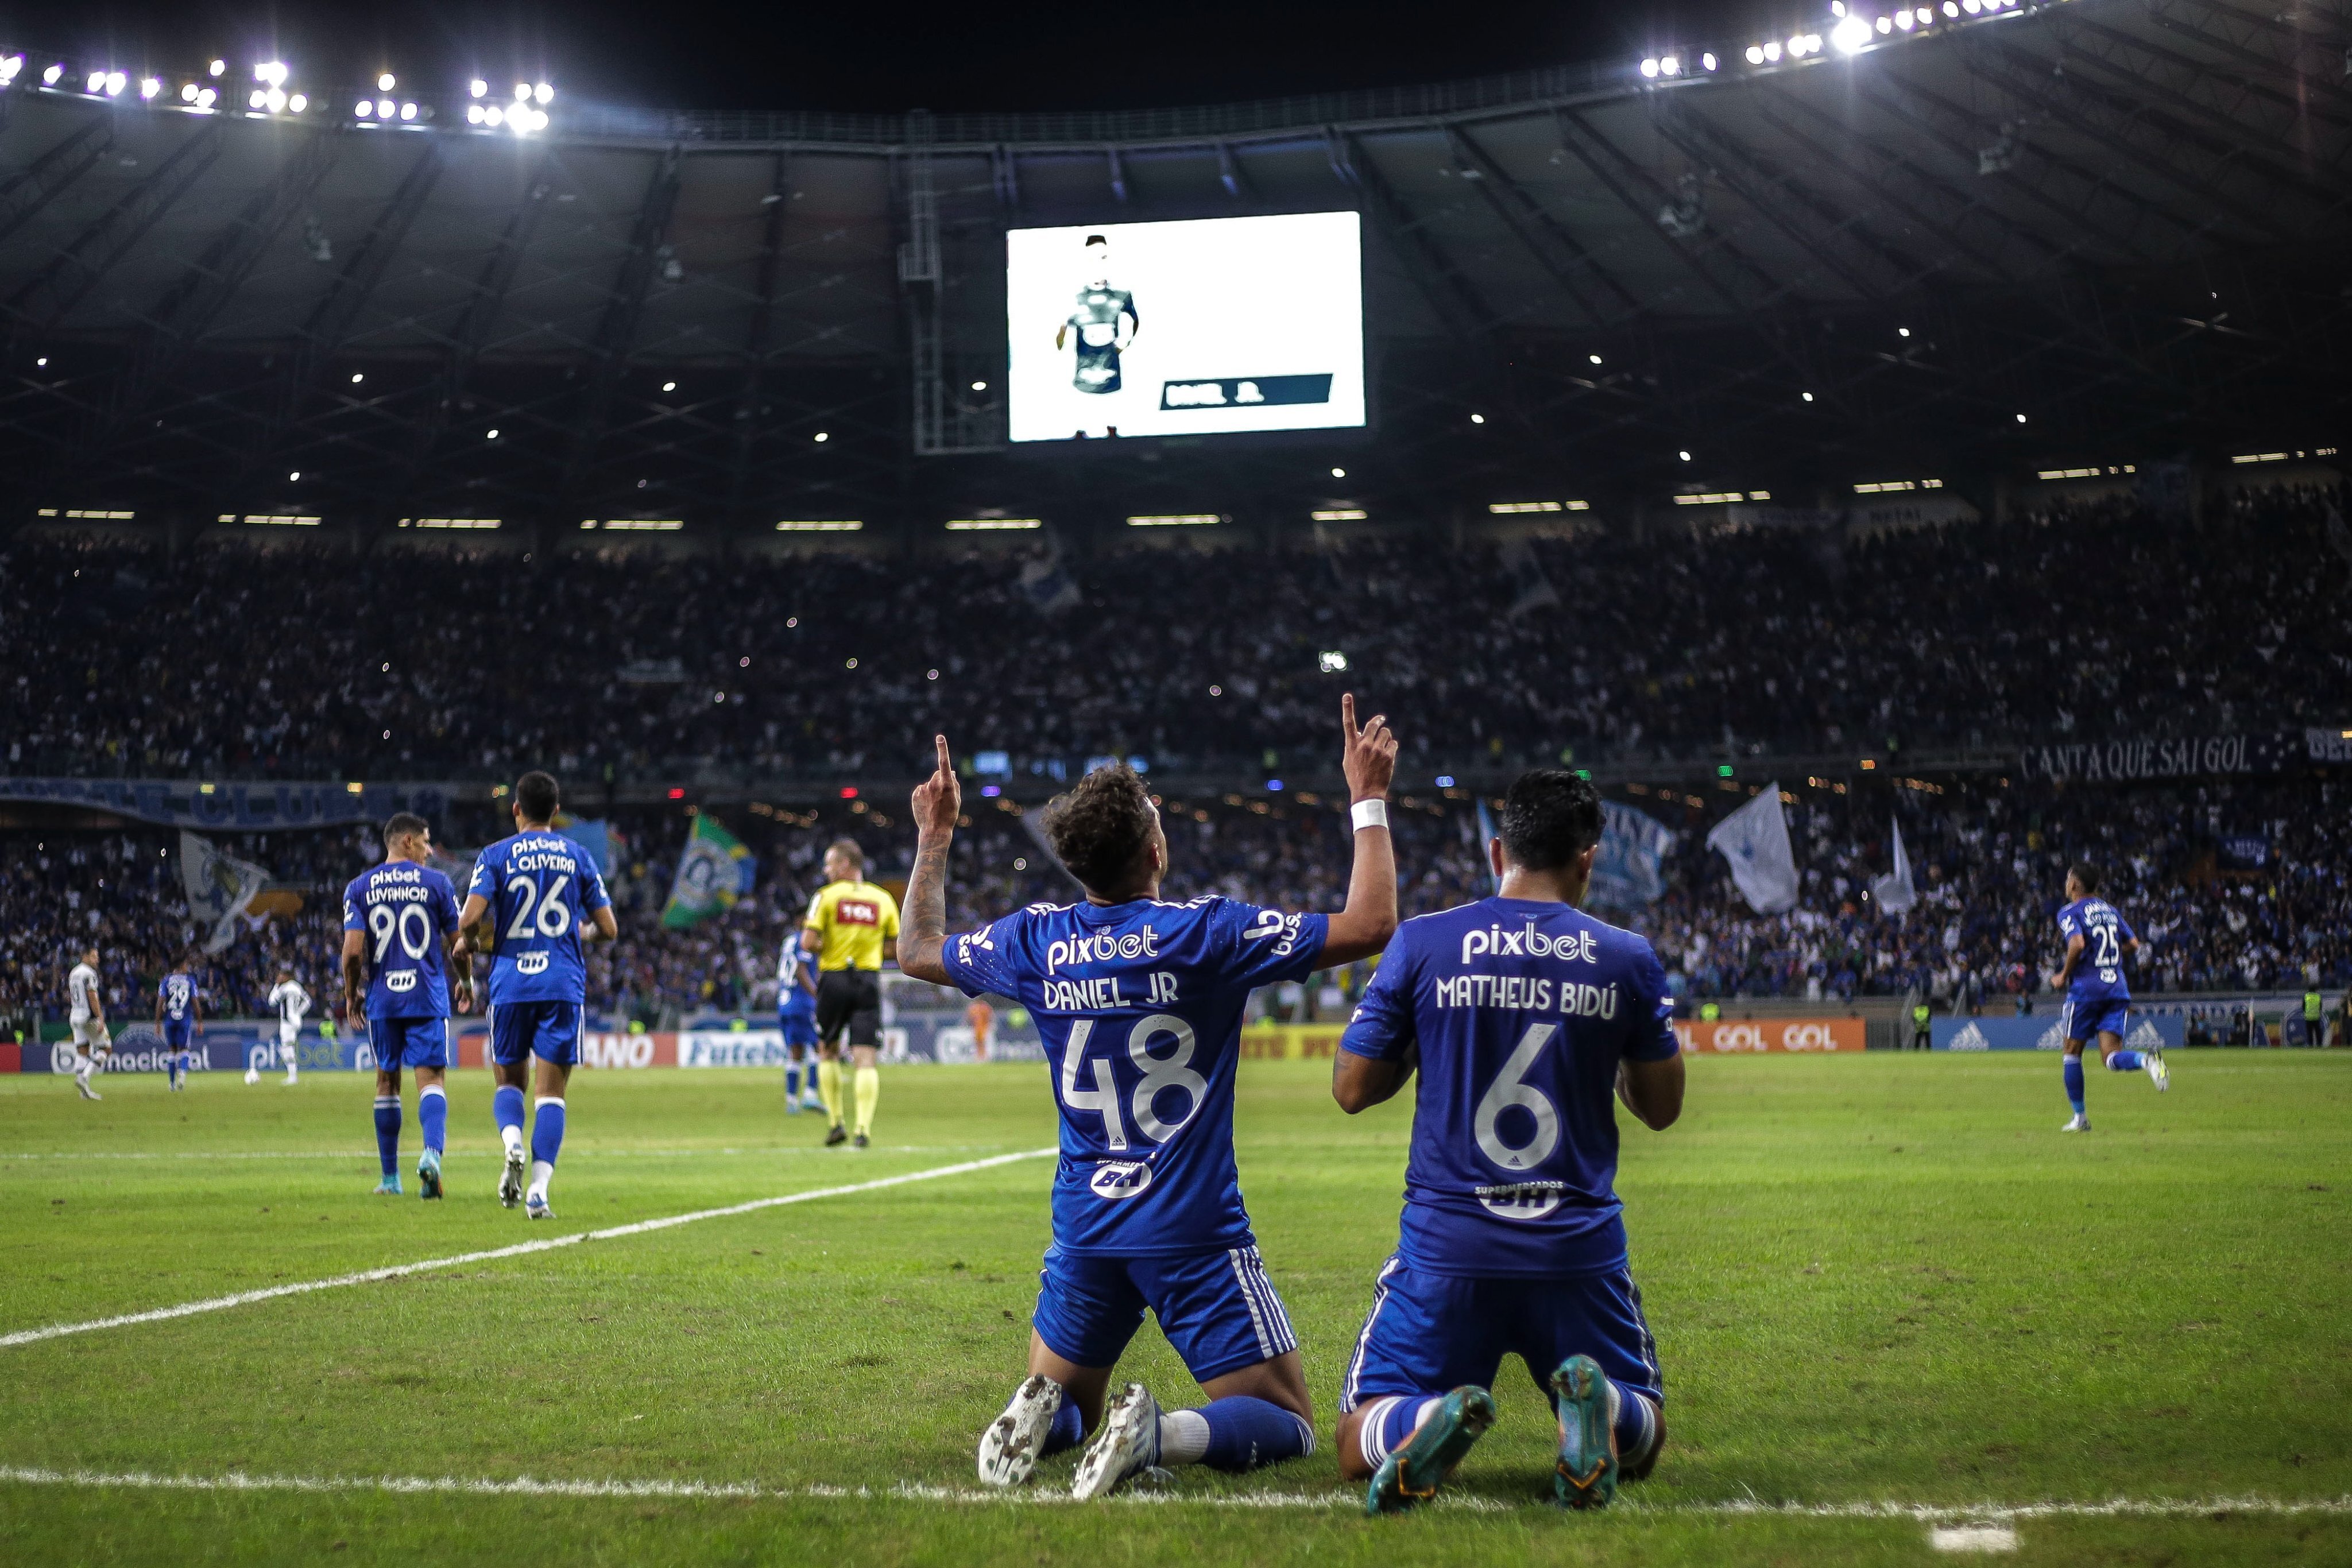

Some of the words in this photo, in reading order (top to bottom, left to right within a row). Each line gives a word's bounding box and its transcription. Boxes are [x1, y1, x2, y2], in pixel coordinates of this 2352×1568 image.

[2107, 738, 2155, 780] QUE
[2158, 738, 2200, 776] SAI
[2204, 735, 2252, 773] GOL
[511, 836, 568, 859] pixbet
[518, 853, 576, 874] OLIVEIRA
[366, 886, 429, 906] LUVANNOR
[370, 868, 421, 890] pixbet
[506, 875, 571, 940] 26
[369, 904, 431, 963] 90
[1047, 924, 1159, 975] pixbet
[1461, 922, 1597, 964] pixbet
[2092, 924, 2119, 967] 25
[167, 984, 191, 1011] 29
[1043, 977, 1130, 1011] DANIEL
[1146, 971, 1179, 1003] JR
[1436, 974, 1552, 1010] MATHEUS
[1559, 981, 1617, 1020] BIDÚ
[1712, 1024, 1768, 1052] GOL
[1782, 1024, 1837, 1052] GOL
[1062, 1014, 1208, 1151] 48
[1474, 1023, 1558, 1171] 6
[1474, 1180, 1564, 1195] SUPERMERCADOS
